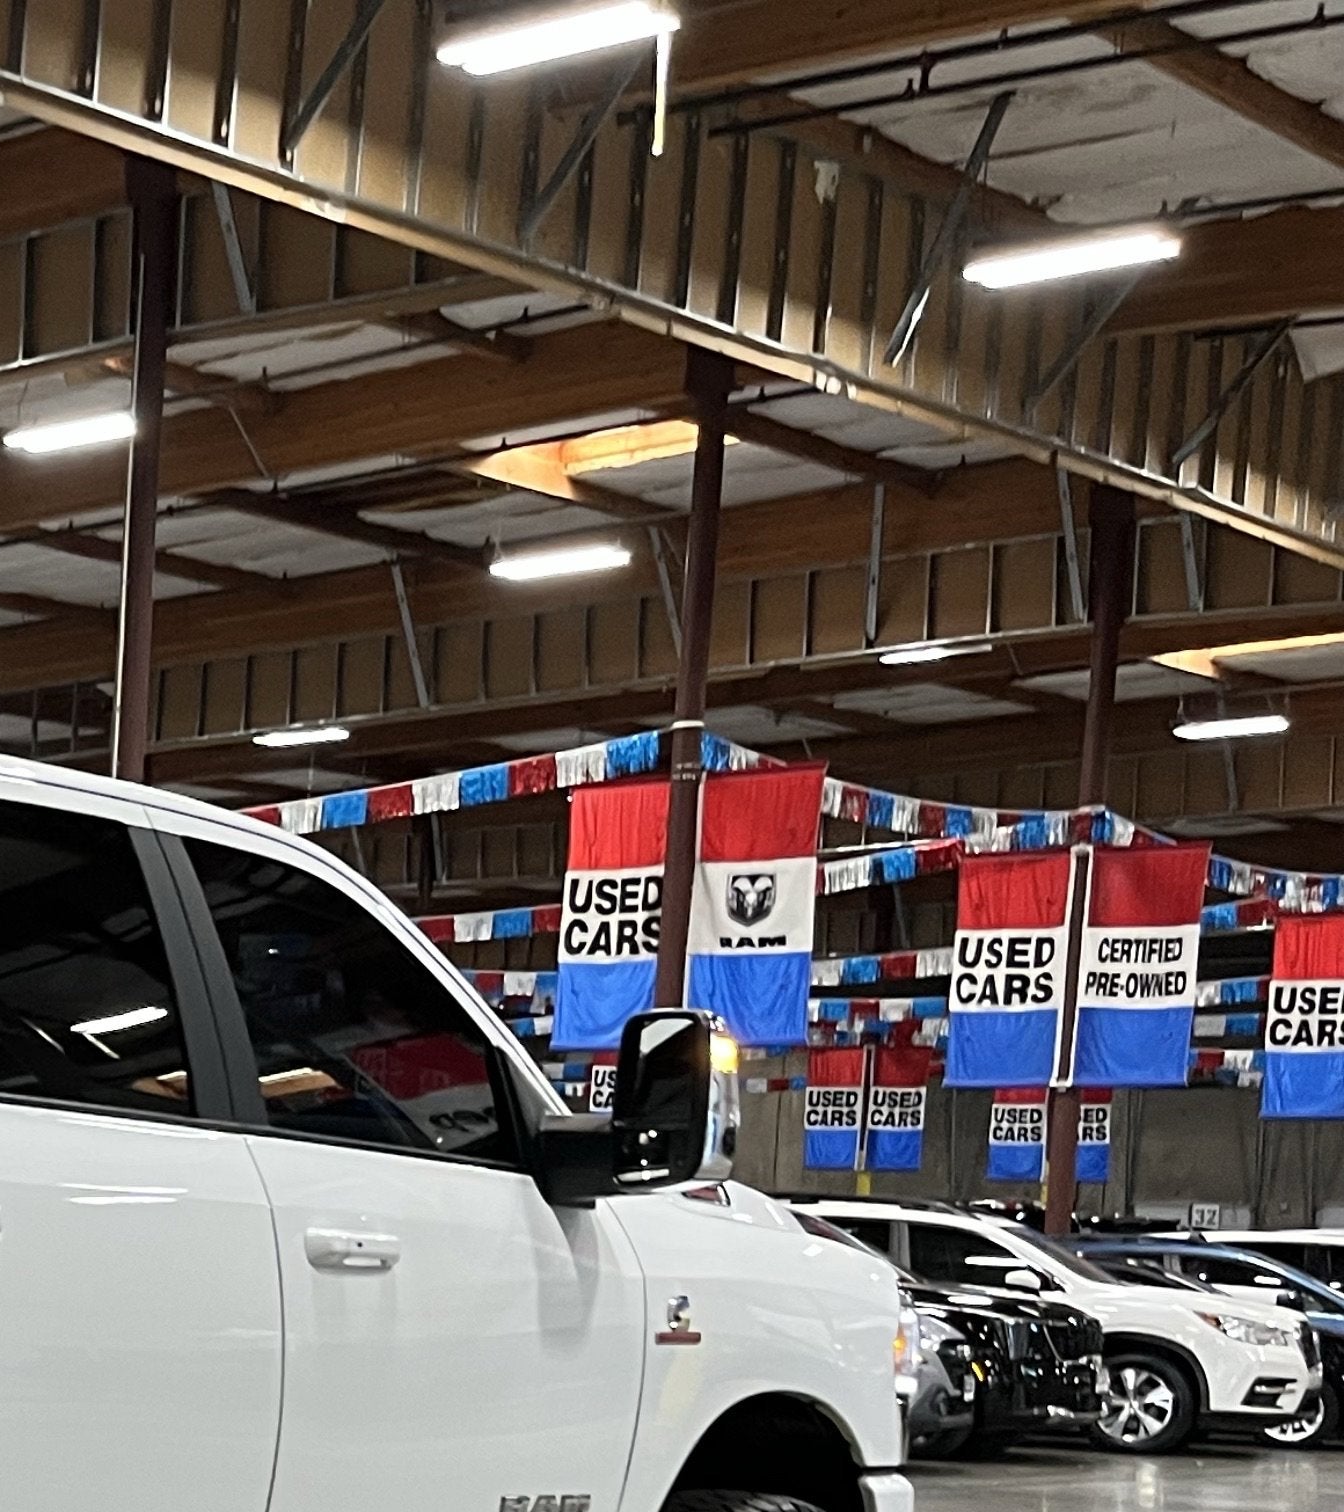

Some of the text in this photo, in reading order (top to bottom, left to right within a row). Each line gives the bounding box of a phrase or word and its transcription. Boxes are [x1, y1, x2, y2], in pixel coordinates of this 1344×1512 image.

[569, 876, 663, 915] USED
[564, 916, 661, 956] CARS
[720, 935, 787, 948] RAM
[958, 937, 1055, 969] USED
[1098, 938, 1183, 963] CERTIFIED
[956, 972, 1053, 1005] CARS
[1085, 971, 1187, 998] PRE-OWNED
[1274, 987, 1344, 1015] USE
[1270, 1019, 1344, 1047] CAR
[594, 1070, 617, 1088] US
[808, 1091, 858, 1107] USED
[872, 1090, 922, 1108] USED
[806, 1110, 857, 1126] CARS
[871, 1110, 921, 1127] CARS
[994, 1108, 1043, 1124] USED
[1083, 1108, 1107, 1123] ED
[993, 1126, 1042, 1142] CARS
[1081, 1126, 1107, 1141] RS
